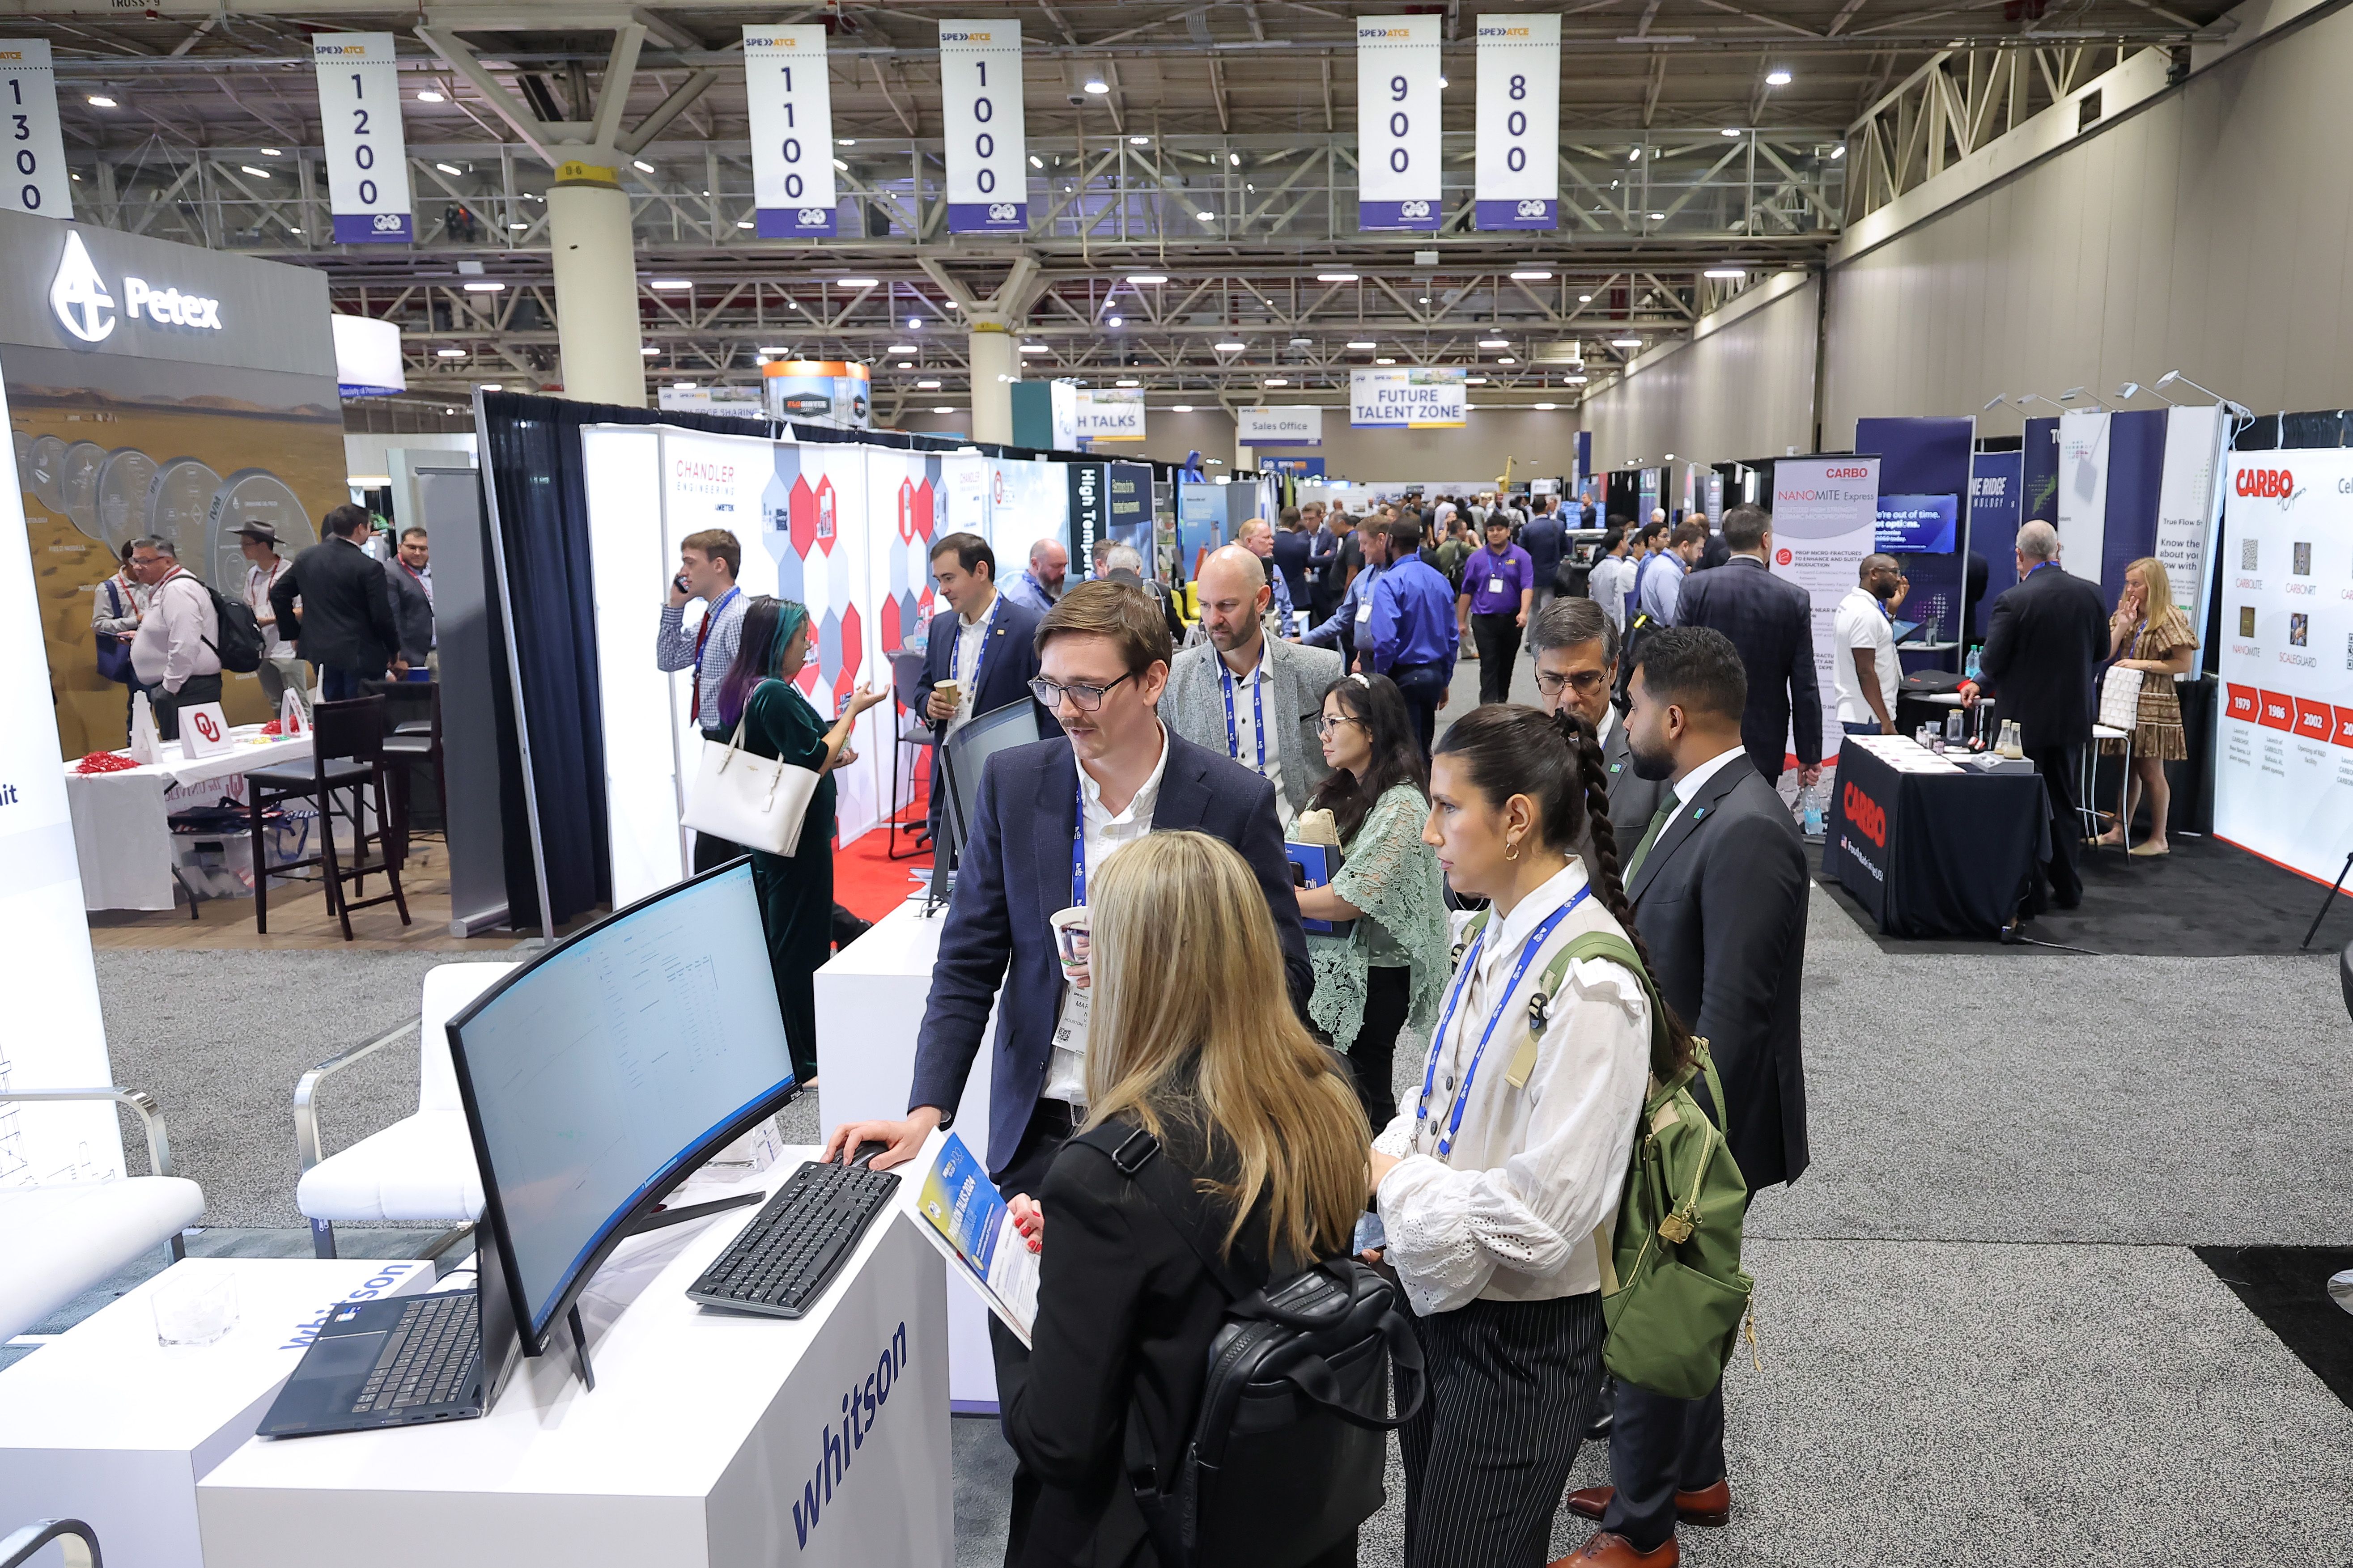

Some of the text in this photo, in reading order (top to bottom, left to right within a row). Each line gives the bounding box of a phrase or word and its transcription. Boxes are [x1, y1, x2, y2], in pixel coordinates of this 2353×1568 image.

[122, 276, 222, 330] Petex
[1379, 390, 1439, 403] FUTURE
[1357, 405, 1461, 419] TALENT ZONE
[1091, 415, 1136, 427] TALKS
[1252, 421, 1308, 430] Sales Office
[677, 460, 734, 483] CHANDLER
[1826, 468, 1868, 478] CARBO
[677, 481, 734, 496] ENGINEERING
[1078, 469, 1096, 507] High
[1982, 477, 2007, 496] RIDGE
[2236, 468, 2293, 498] CARBO
[1778, 489, 1874, 503] NANOMITE Express
[1893, 511, 1907, 519] out
[1908, 509, 1919, 519] of
[1919, 510, 1941, 519] time.
[1885, 519, 1921, 530] options.
[2161, 538, 2200, 549] Know the
[2160, 551, 2184, 559] about
[2178, 562, 2197, 571] with
[2236, 578, 2263, 590] CARBOLITE
[2233, 644, 2317, 668] NANOMITE SCALEGUARD
[2234, 696, 2251, 711] 1979
[2268, 704, 2286, 720] 1986
[2303, 712, 2323, 729] 2002
[1844, 781, 1886, 848] CARBO
[947, 1174, 976, 1238] PAVILION TALKS 2024
[792, 1320, 907, 1552] whitson
